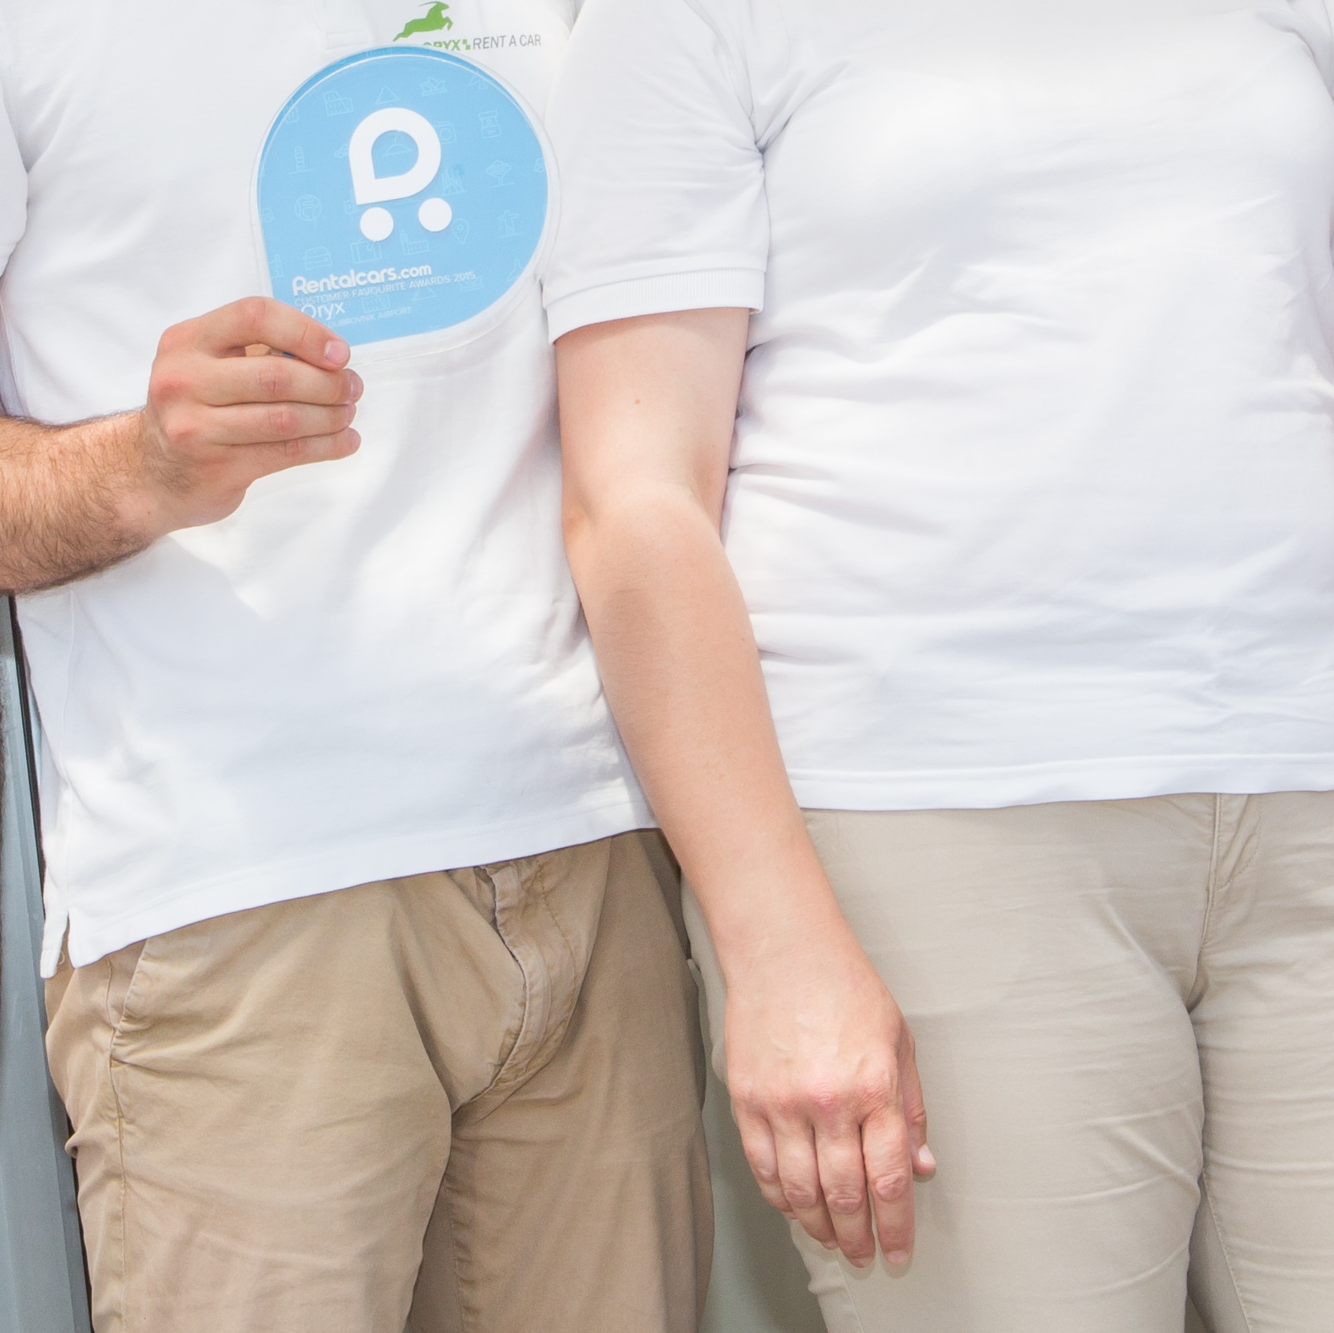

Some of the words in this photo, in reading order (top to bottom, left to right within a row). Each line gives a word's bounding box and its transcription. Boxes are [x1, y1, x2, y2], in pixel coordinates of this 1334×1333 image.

[472, 35, 507, 50] RENT
[509, 35, 517, 47] A
[519, 34, 542, 47] CAR
[291, 264, 432, 297] Rentalcars.com
[294, 290, 350, 307] CUSTOMER
[352, 280, 407, 297] FAVOURITE
[409, 273, 451, 289] AWARDS
[454, 270, 476, 282] 2015
[300, 301, 346, 321] Oryx
[378, 306, 412, 319] AIRPORT
